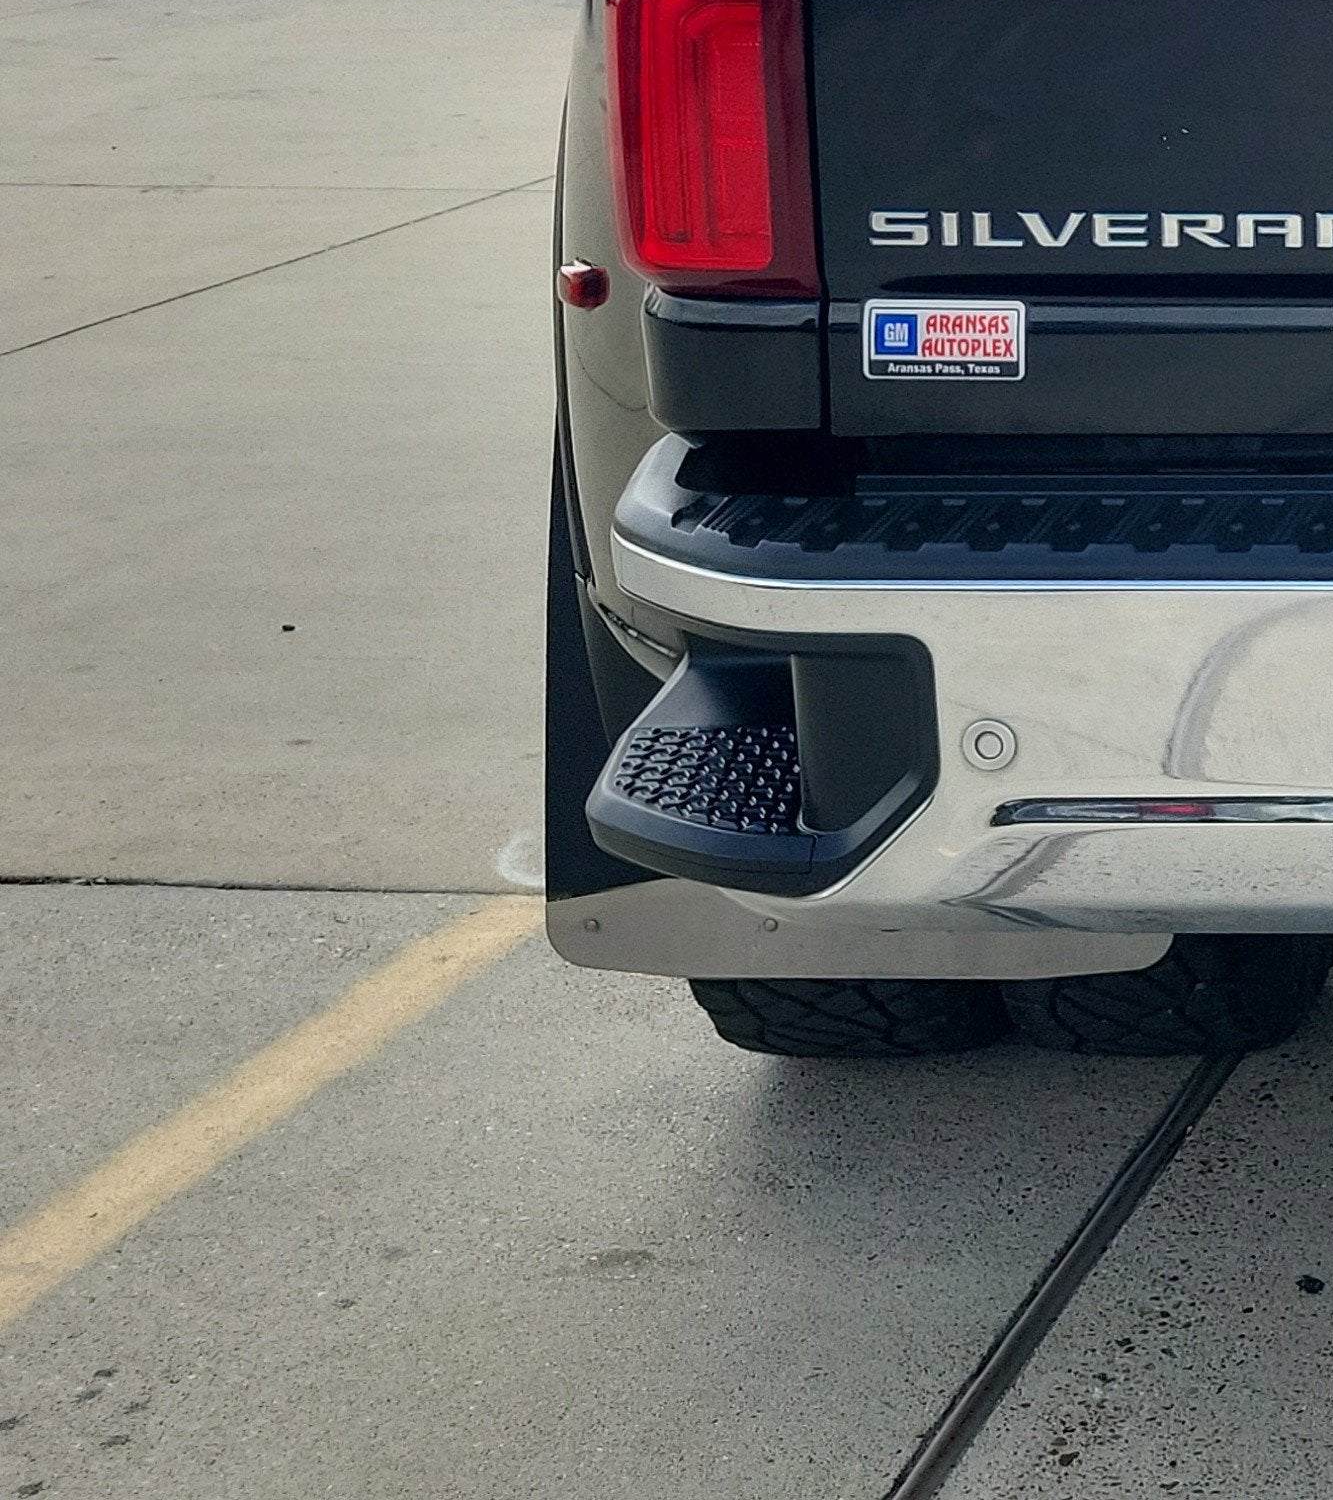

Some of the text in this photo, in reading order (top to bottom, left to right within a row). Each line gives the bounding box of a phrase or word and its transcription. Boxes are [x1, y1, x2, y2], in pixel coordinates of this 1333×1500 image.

[884, 323, 908, 342] GM
[926, 314, 1010, 336] ARANSAS
[921, 338, 1014, 358] AUTOPLEX
[887, 362, 1001, 375] Aransas Pass, Texas
